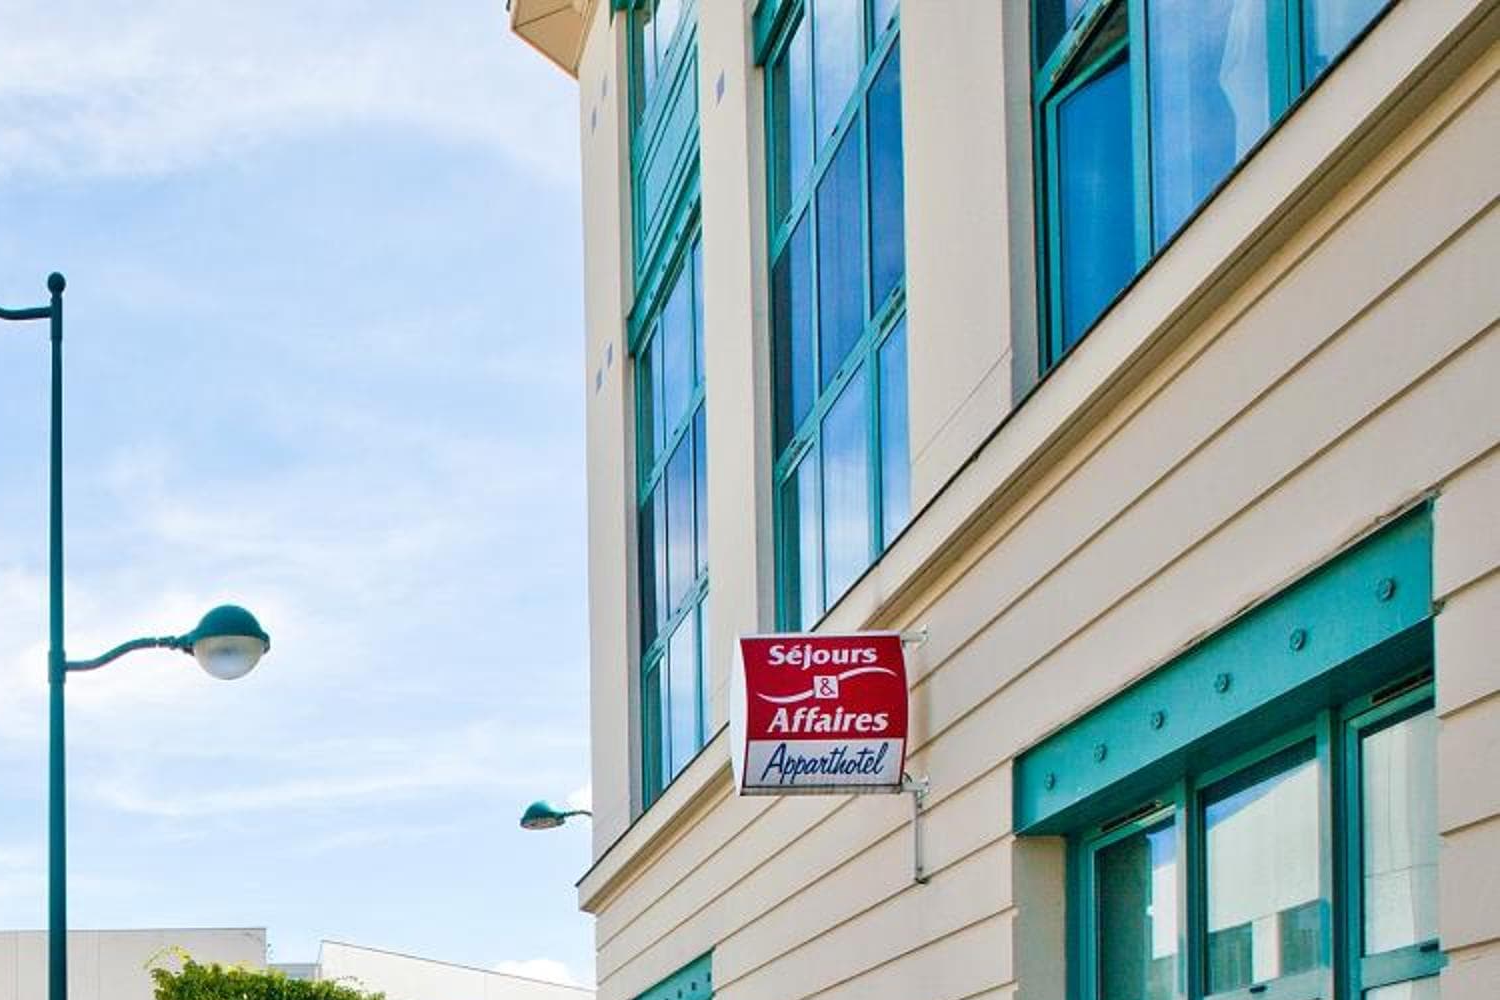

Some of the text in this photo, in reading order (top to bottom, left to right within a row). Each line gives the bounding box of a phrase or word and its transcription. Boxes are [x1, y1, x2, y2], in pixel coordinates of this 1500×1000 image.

[767, 643, 878, 671] Séjours
[818, 677, 837, 697] &
[766, 706, 889, 733] Affaires
[761, 741, 889, 784] Apparthotel
